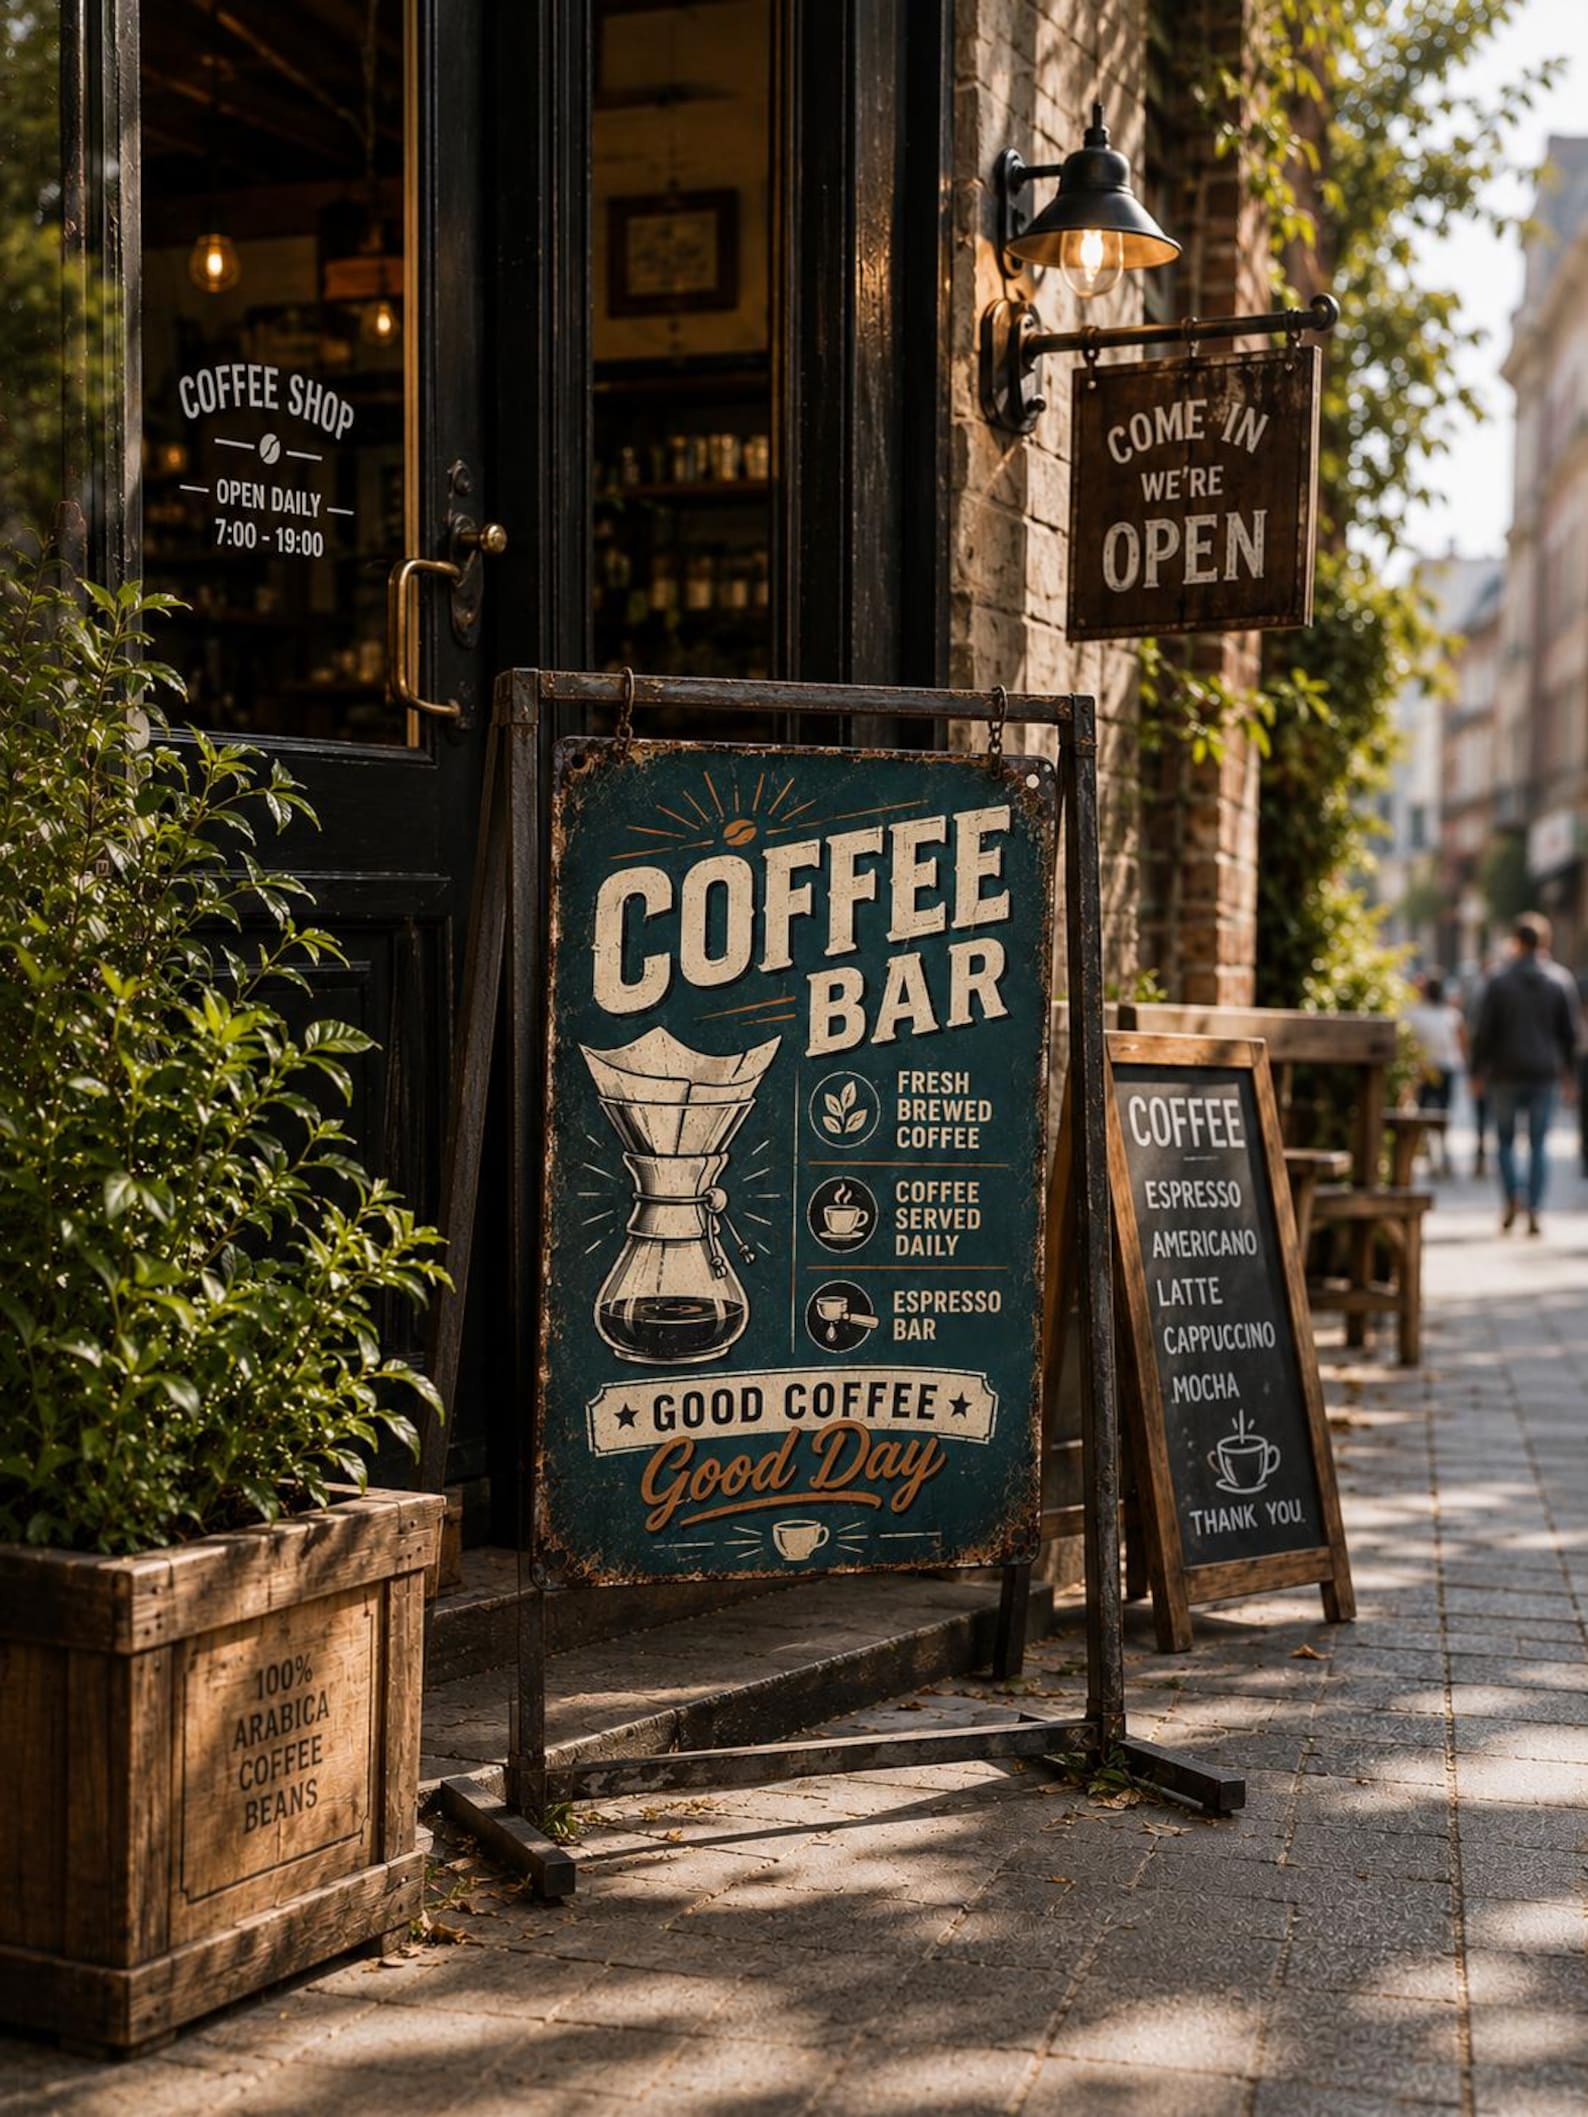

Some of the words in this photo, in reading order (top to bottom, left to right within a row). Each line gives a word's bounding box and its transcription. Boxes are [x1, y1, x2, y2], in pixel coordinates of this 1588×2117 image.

[178, 363, 280, 419] COFFEE
[288, 374, 355, 440] SHOP
[1107, 398, 1208, 464] COME
[1221, 401, 1270, 454] IN
[216, 478, 265, 510] OPEN
[271, 486, 322, 518] DAILY
[1140, 465, 1224, 502] WE'RE
[214, 517, 257, 549] 7:00
[275, 526, 324, 558] 19:00
[1102, 509, 1268, 593] OPEN
[591, 804, 1012, 1015] COFFEE
[804, 936, 1009, 1058] BAR
[897, 1070, 970, 1095] FRESH
[896, 1098, 993, 1123] BREWED
[1128, 1095, 1246, 1148] COFFEE
[896, 1126, 980, 1149] COFFEE
[895, 1180, 980, 1204] COFFEE
[1145, 1180, 1242, 1209] ESPRESSO
[895, 1207, 981, 1230] SERVED
[895, 1234, 960, 1257] DAILY
[1152, 1229, 1258, 1259] AMERICANO
[893, 1289, 1002, 1314] ESPRESSO
[1156, 1276, 1224, 1307] LATTE
[893, 1317, 937, 1341] BAR
[1163, 1320, 1277, 1355] CAPPUCCINO
[652, 1386, 764, 1432] GOOD
[784, 1380, 940, 1420] COFFEE
[1172, 1371, 1241, 1404] MOCHA
[641, 1425, 801, 1533] Good
[809, 1419, 947, 1514] Day
[1189, 1503, 1258, 1537] THANK
[257, 1652, 314, 1701] 100%
[232, 1690, 330, 1752] ARABICA
[238, 1733, 324, 1792] COFFEE
[243, 1778, 318, 1835] BEANS
